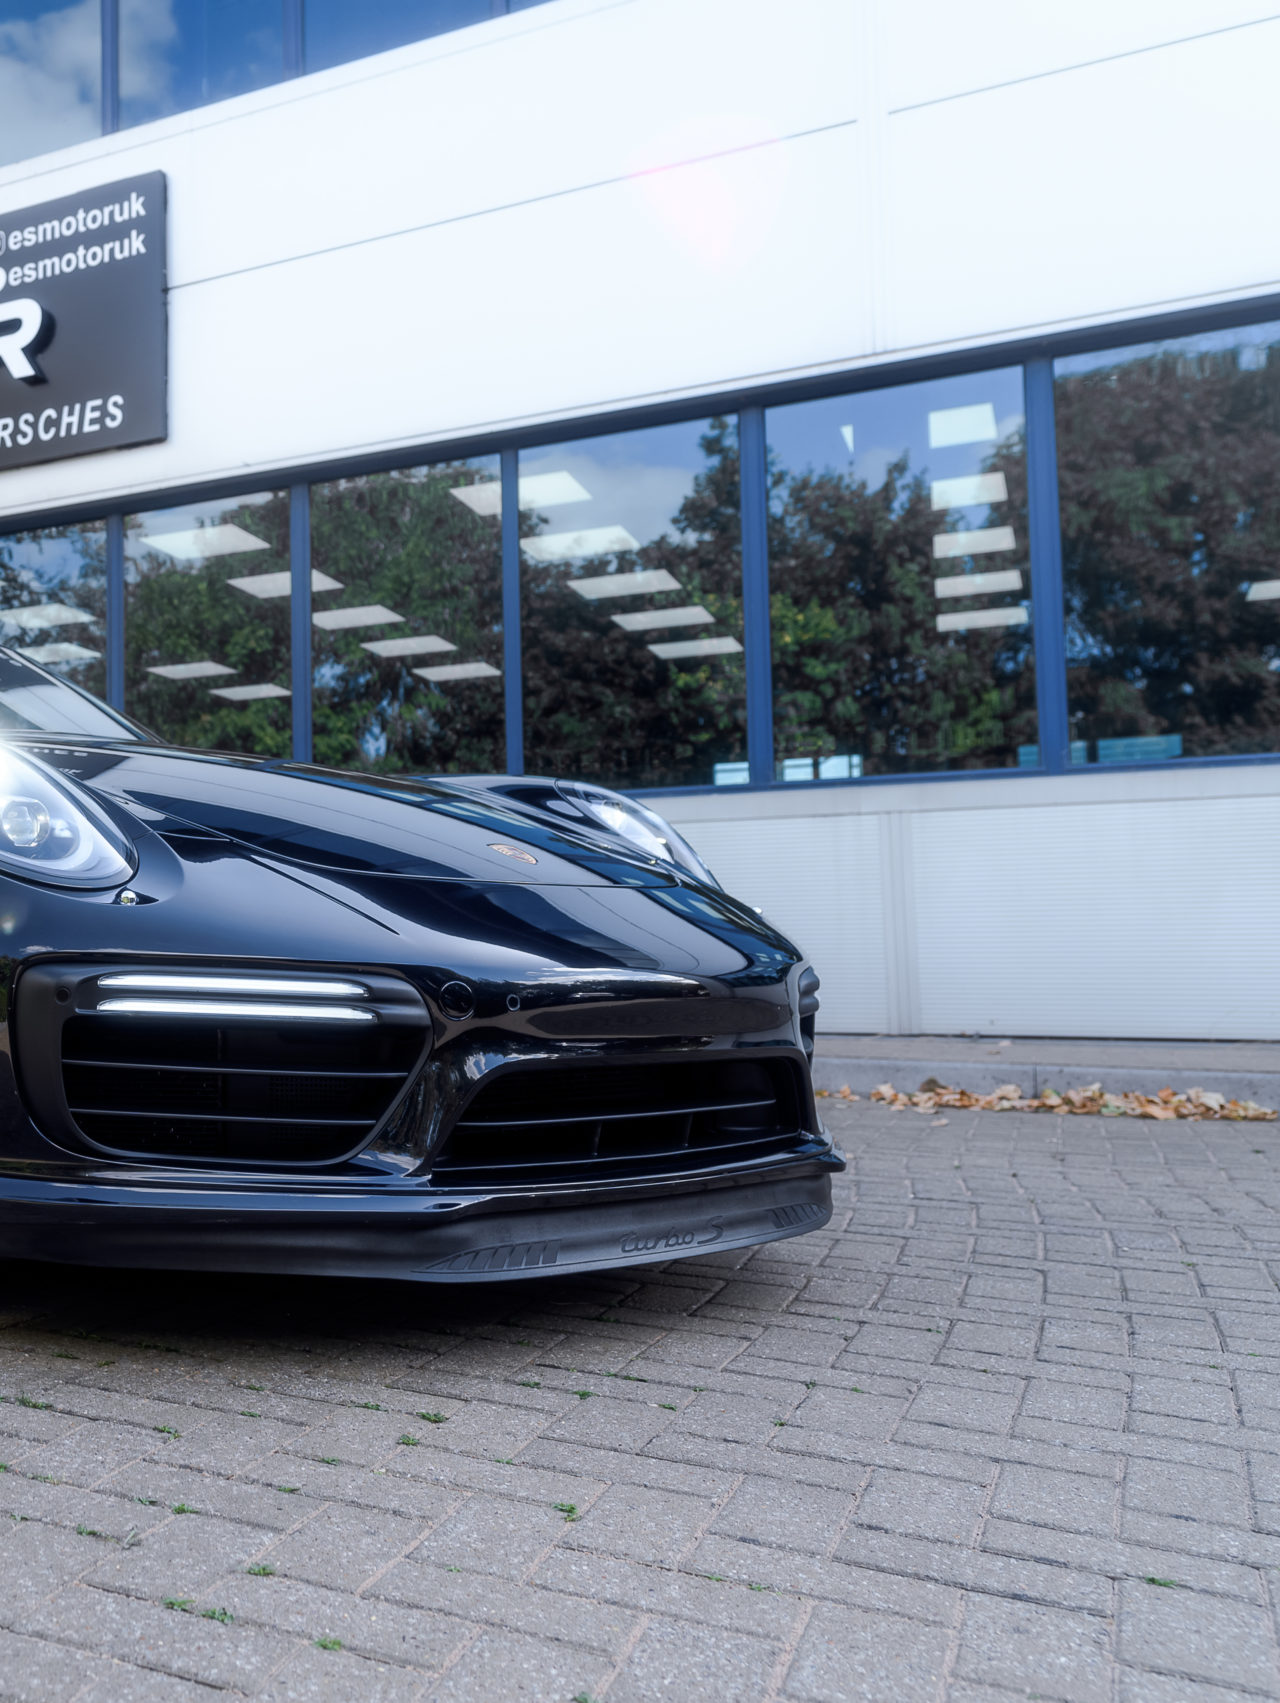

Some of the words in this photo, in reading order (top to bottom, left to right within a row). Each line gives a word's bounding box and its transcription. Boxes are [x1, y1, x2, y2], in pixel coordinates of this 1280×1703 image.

[7, 192, 146, 252] esmotoruk
[7, 230, 147, 288] esmotoruk
[696, 1215, 724, 1246] S
